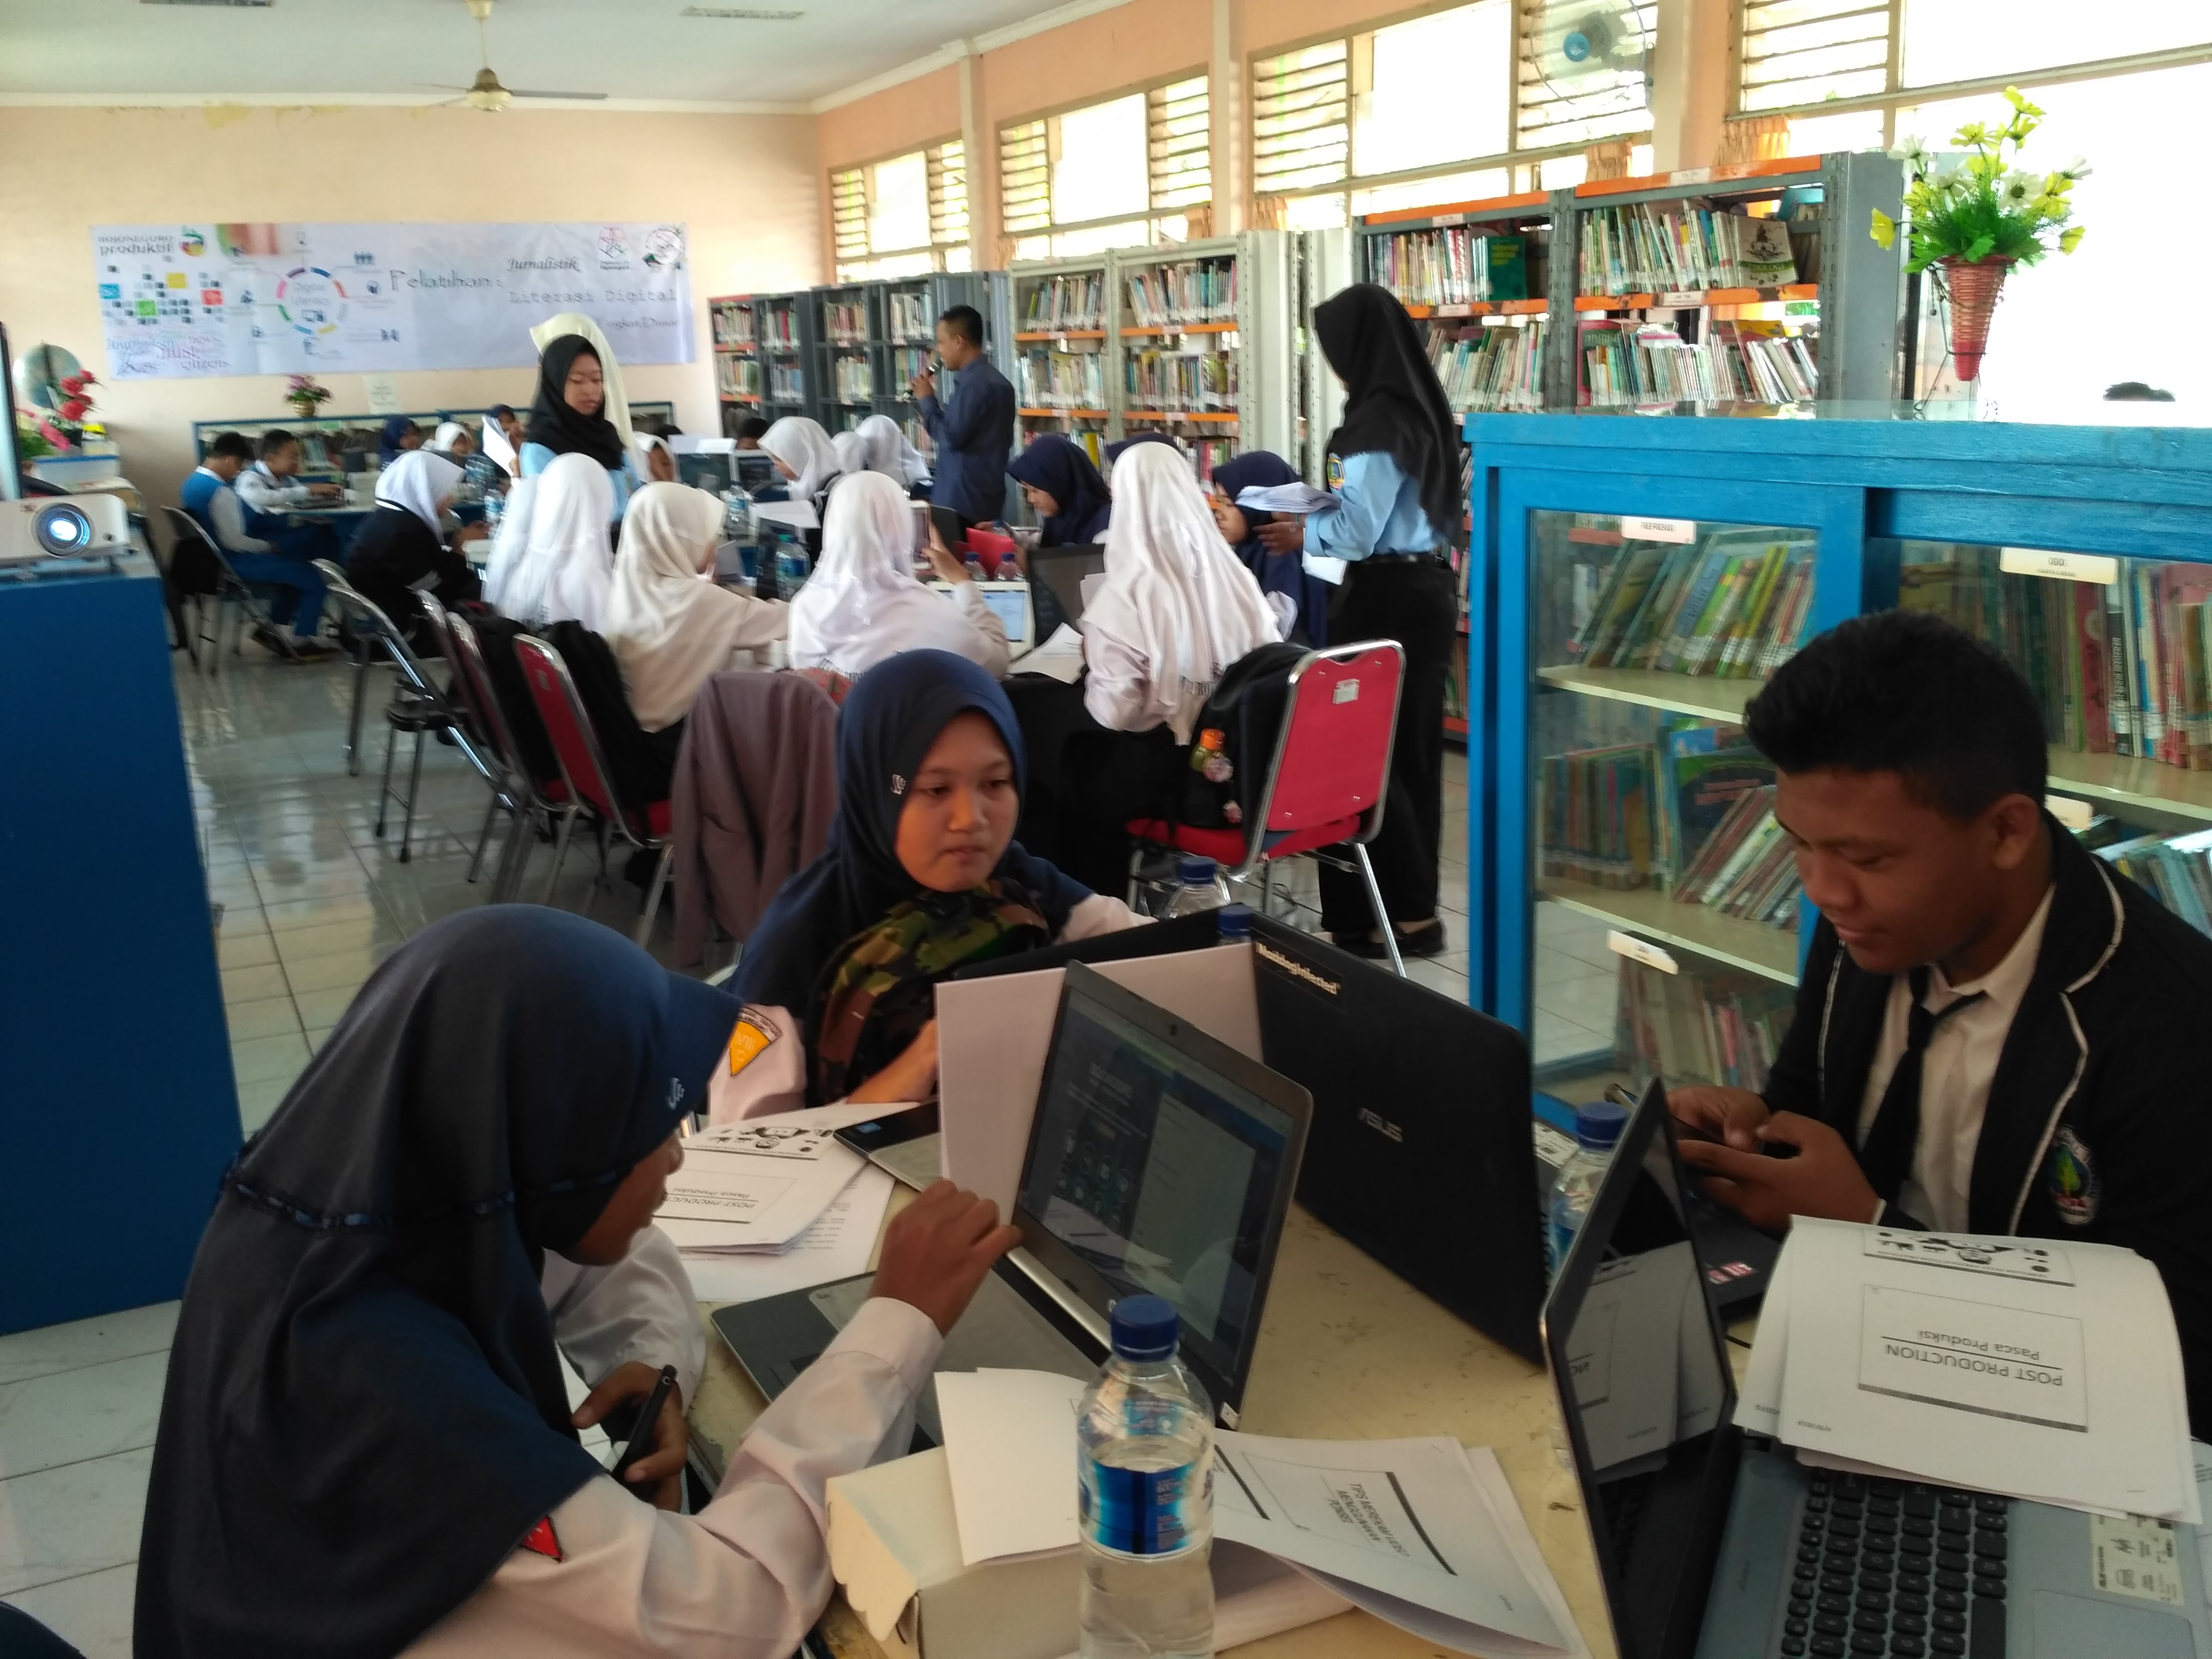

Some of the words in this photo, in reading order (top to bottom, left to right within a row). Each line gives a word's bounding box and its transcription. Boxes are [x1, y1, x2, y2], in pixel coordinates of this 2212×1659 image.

[100, 242, 172, 255] produktif
[507, 256, 583, 273] Jurnalistik
[509, 291, 595, 304] Literasi
[605, 289, 677, 304] Digital
[1918, 1330, 1988, 1352] Produksi
[1994, 1343, 2040, 1360] Pasca
[1886, 1344, 2009, 1377] PRODUCTION
[2015, 1368, 2063, 1386] POST
[1350, 1484, 1368, 1499] TIPS
